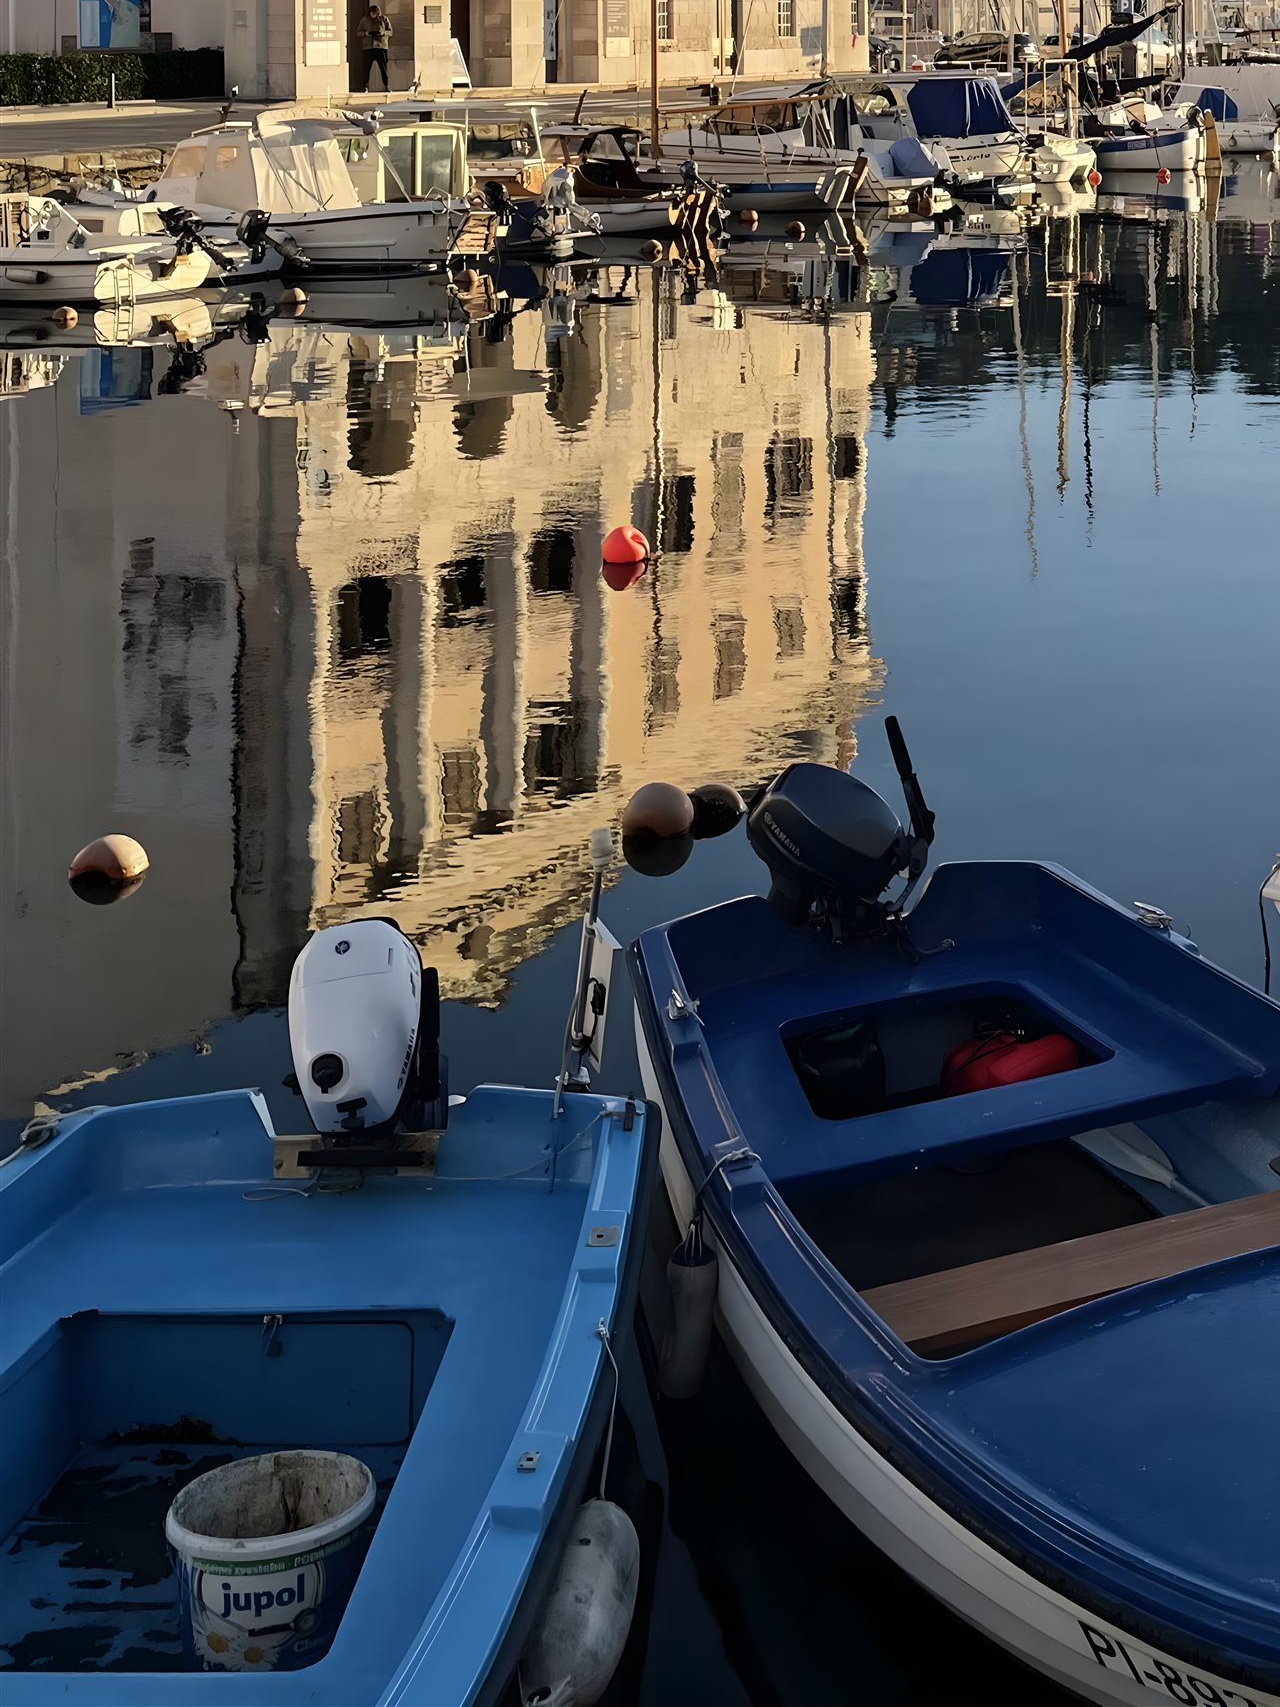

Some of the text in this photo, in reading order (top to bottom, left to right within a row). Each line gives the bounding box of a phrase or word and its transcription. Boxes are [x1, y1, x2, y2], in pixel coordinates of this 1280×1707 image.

[1120, 0, 1129, 13] P
[769, 821, 800, 857] YAMAHA
[221, 1573, 305, 1618] jupol
